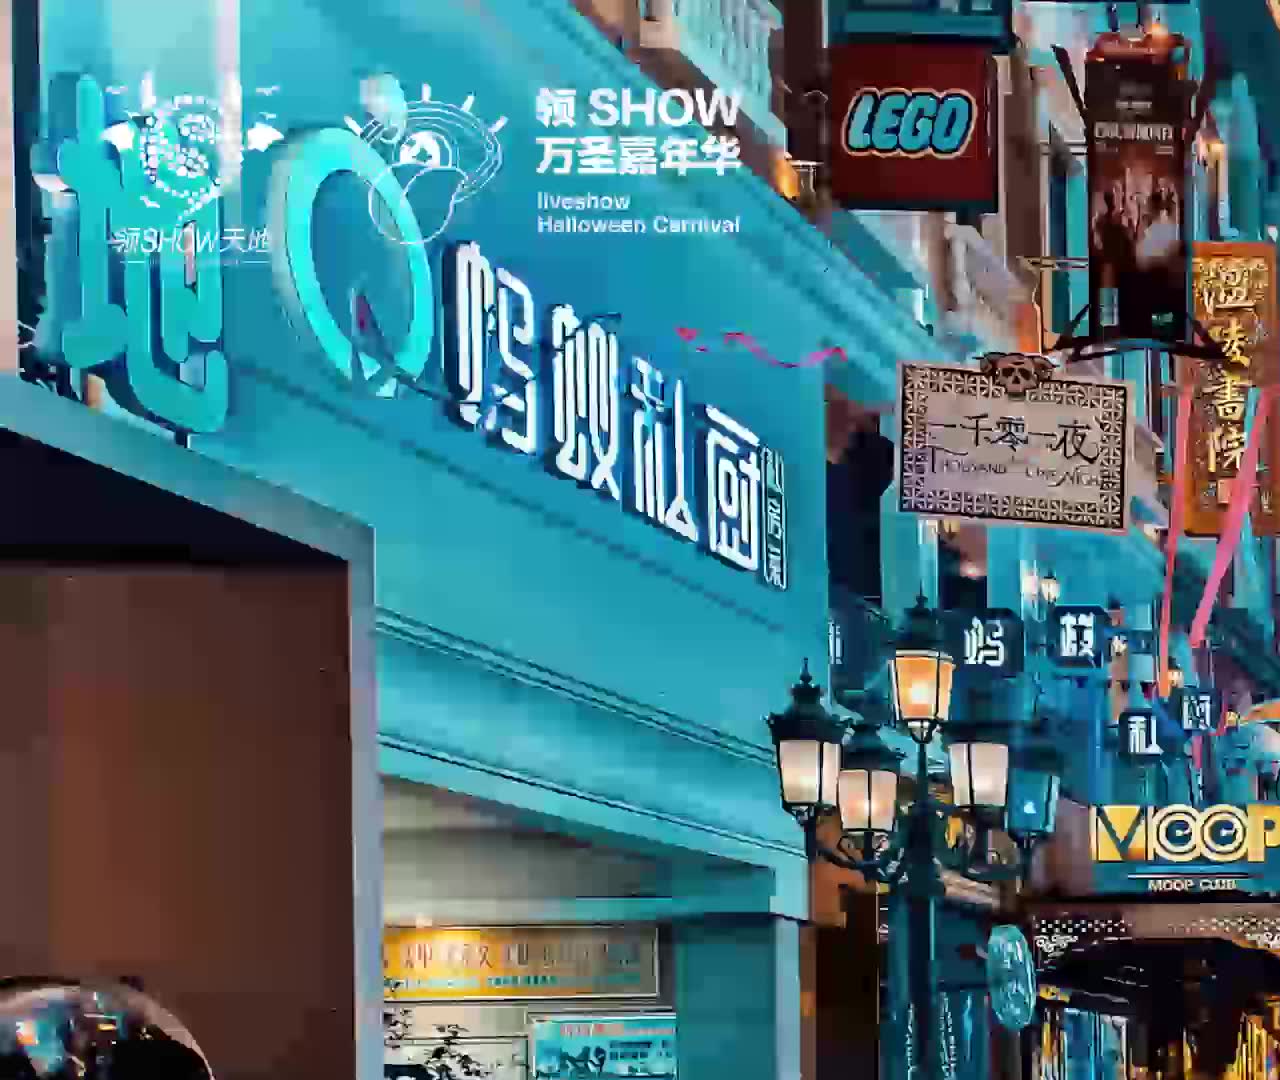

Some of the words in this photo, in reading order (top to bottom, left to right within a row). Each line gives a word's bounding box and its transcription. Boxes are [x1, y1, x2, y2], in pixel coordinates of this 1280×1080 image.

[843, 90, 976, 158] LEGO
[924, 412, 1100, 462] 一千零一夜
[1148, 879, 1195, 892] MOOP
